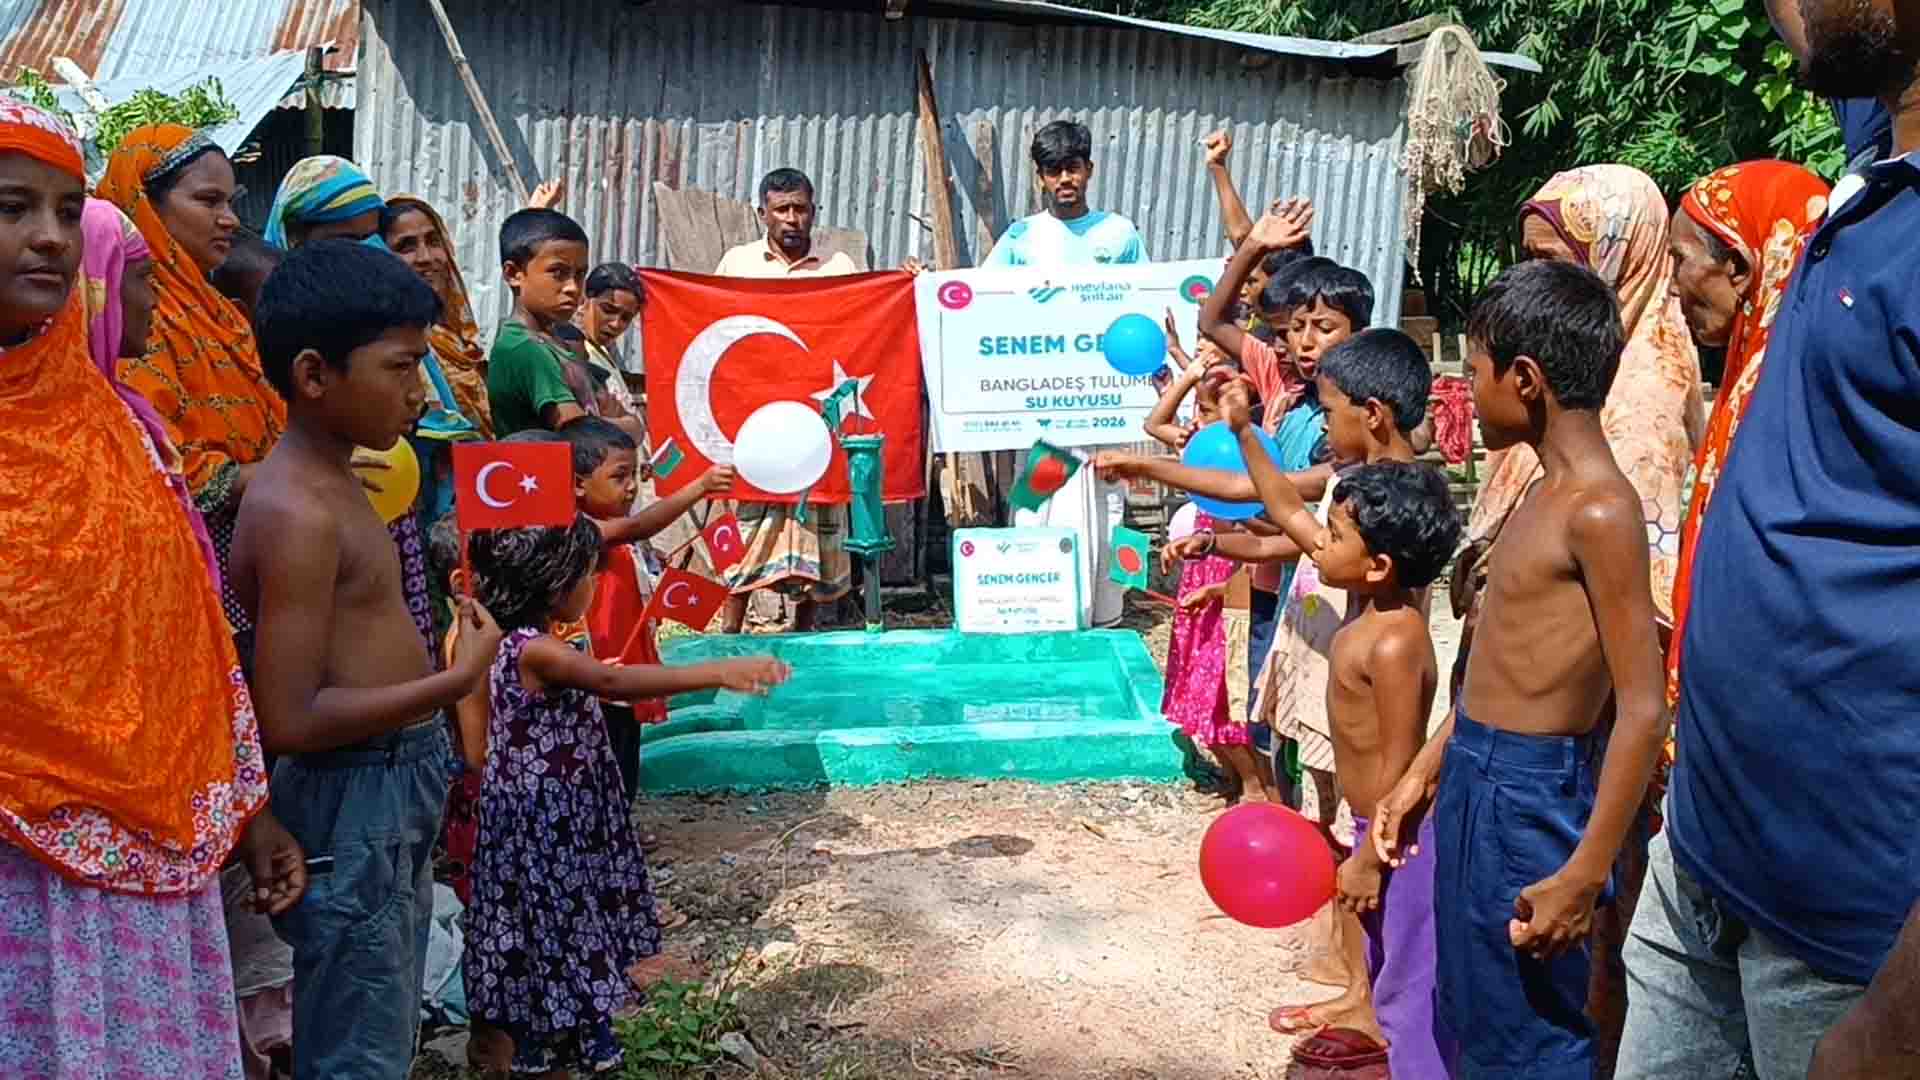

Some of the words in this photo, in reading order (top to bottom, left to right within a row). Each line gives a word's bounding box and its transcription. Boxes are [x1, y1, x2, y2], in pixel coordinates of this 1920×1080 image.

[978, 334, 1065, 356] SENEM
[980, 376, 1086, 392] BANGLADEŞ
[1089, 375, 1154, 389] TULUM
[1025, 396, 1048, 409] SU
[1052, 393, 1122, 408] KUYUSU
[1092, 416, 1126, 428] 2026
